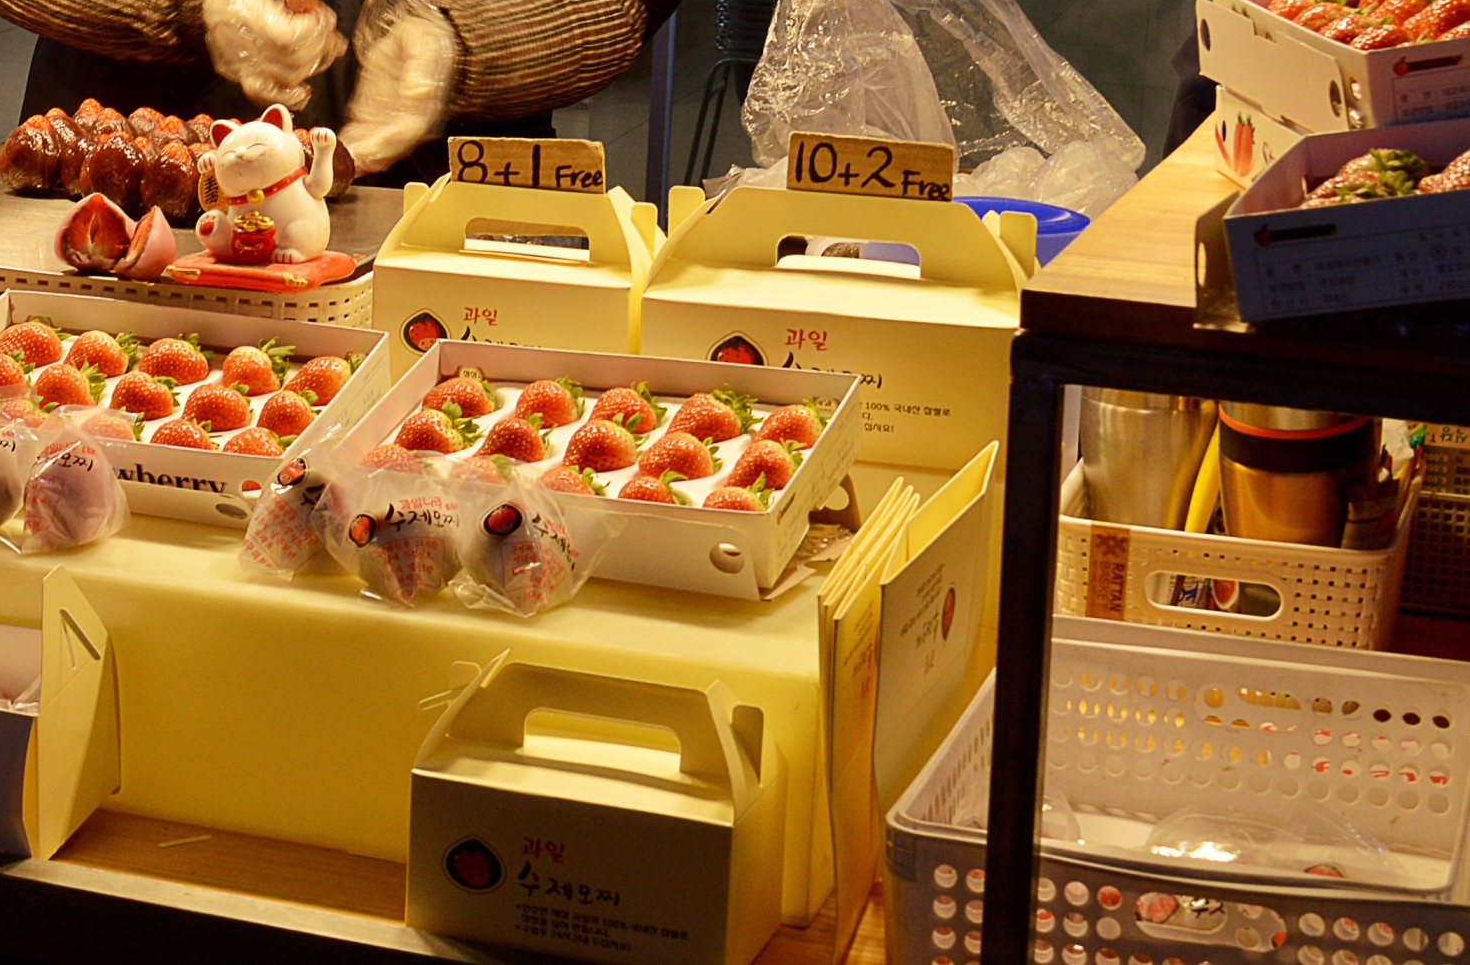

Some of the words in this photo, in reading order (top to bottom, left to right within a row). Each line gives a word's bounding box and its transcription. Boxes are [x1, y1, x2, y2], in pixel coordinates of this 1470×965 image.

[457, 140, 542, 187] 8+1
[555, 164, 604, 188] Free
[794, 136, 897, 188] 10+2
[901, 169, 951, 201] Free
[462, 306, 499, 327] 과일
[784, 328, 829, 352] 과일
[865, 402, 890, 412] 100%
[894, 403, 921, 415] 국내산
[384, 503, 461, 532] 수제모찌
[1108, 562, 1126, 613] RATTAN
[521, 835, 566, 863] 과일
[517, 860, 621, 907] 수제모찌
